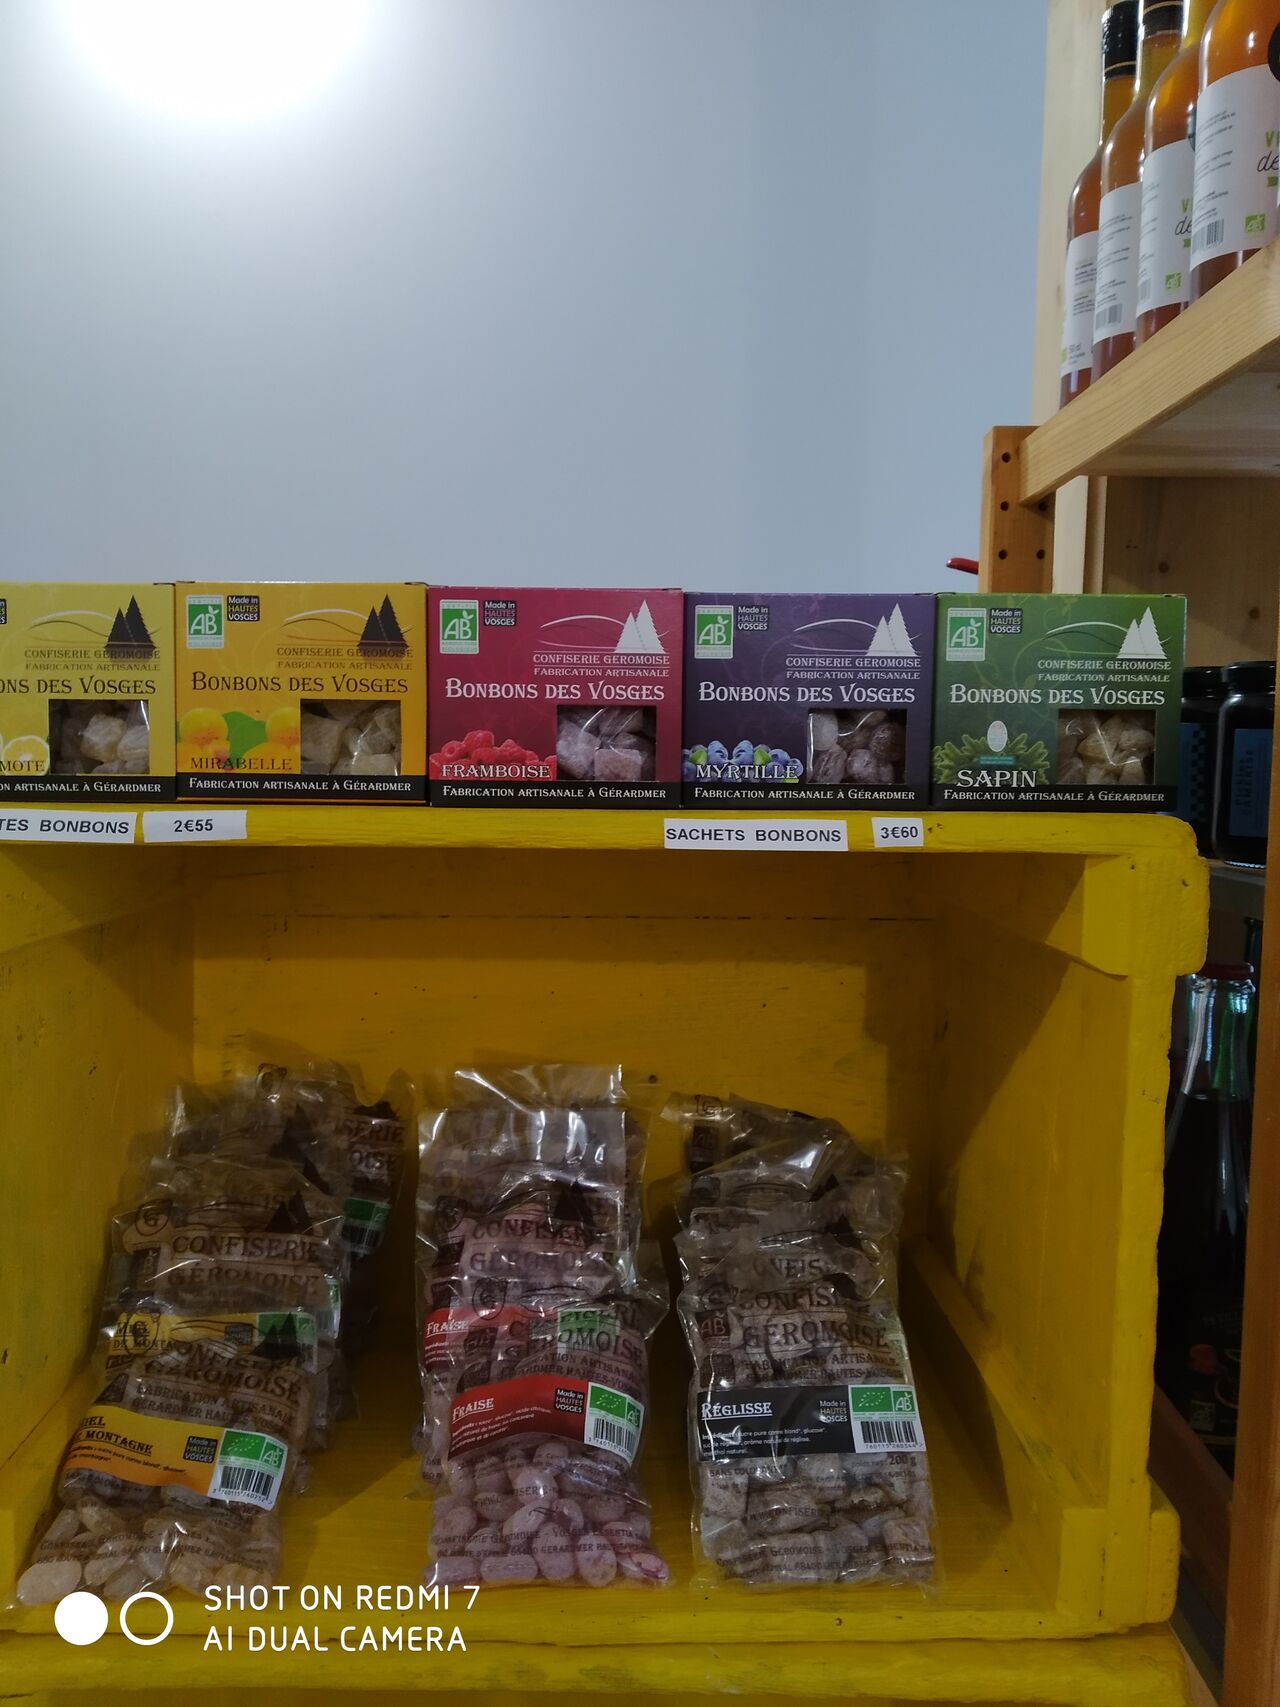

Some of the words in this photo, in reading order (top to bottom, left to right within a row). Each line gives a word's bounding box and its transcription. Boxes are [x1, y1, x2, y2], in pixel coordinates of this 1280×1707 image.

[190, 613, 217, 634] AB
[444, 618, 472, 639] AB
[699, 623, 726, 644] AB
[951, 626, 979, 646] AB
[25, 650, 90, 659] CONFISERIE
[277, 647, 343, 657] CONFISERIE
[278, 660, 345, 670] FABRICATION
[349, 661, 412, 670] ARTISANALE
[533, 654, 600, 664] CONFISERIE
[603, 655, 670, 665] GEROMOISE
[786, 657, 852, 667] CONFISERIE
[855, 658, 920, 667] GEROMOISE
[1037, 660, 1103, 669] CONFISERIE
[1106, 660, 1171, 670] GEROMOISE
[26, 663, 92, 671] FABRICATION
[97, 663, 160, 671] ARTISANALE
[534, 667, 602, 676] FABRICATION
[605, 668, 669, 677] ARTISANALE
[192, 671, 281, 692] BONBONS
[289, 677, 324, 692] DES
[332, 674, 408, 693] VOSGES
[786, 671, 854, 679] FABRICATION
[856, 671, 920, 680] ARTISANALE
[1038, 673, 1104, 682] FABRICATION
[1108, 674, 1170, 682] ARTISANALE
[38, 679, 72, 694] DES
[79, 675, 156, 694] VOSGES
[446, 678, 538, 699] BONBONS
[545, 684, 581, 699] DES
[587, 680, 664, 700] VOSGES
[699, 681, 790, 702] BONBONS
[798, 687, 833, 702] DES
[840, 682, 915, 703] VOSGES
[950, 683, 1042, 704] BONBONS
[1049, 689, 1084, 704] DES
[1090, 684, 1165, 705] VOSGES
[190, 757, 292, 770] MIRABELLE
[442, 765, 550, 778] FRAMBOISE
[696, 764, 798, 781] MYRTILLE
[189, 777, 259, 789] FABRICATION
[262, 781, 329, 790] ARTISANALE
[343, 779, 411, 791] GÉRARDMER
[956, 769, 1037, 788] SAPIN
[14, 783, 79, 792] ARTISANALE
[94, 781, 161, 792] GÉRARDMER
[443, 785, 514, 797] FABRICATION
[518, 788, 583, 797] ARTISANALE
[599, 787, 666, 798] GÉRARDMER
[695, 787, 764, 798] FABRICATION
[768, 790, 833, 799] ARTISANALE
[848, 788, 915, 800] GÉRARDMER
[944, 789, 1015, 800] FABRICATION
[1019, 791, 1083, 801] ARTISANALE
[1098, 790, 1164, 802] GÉRARDMER
[40, 820, 129, 833] BONBONS
[174, 819, 213, 832] 2€55
[666, 828, 745, 841] SACHETS
[755, 829, 841, 842] BONBONS
[880, 826, 918, 839] 3€60
[556, 1389, 576, 1398] Made
[555, 1397, 583, 1406] HAUTES
[555, 1403, 582, 1413] VOSGES
[896, 1397, 912, 1411] AB
[453, 1397, 494, 1421] FRAISE
[702, 1402, 773, 1418] RÉGLISSE
[81, 1415, 105, 1427] IEL
[86, 1430, 153, 1453] MONTAGNE
[889, 1455, 908, 1466] 200
